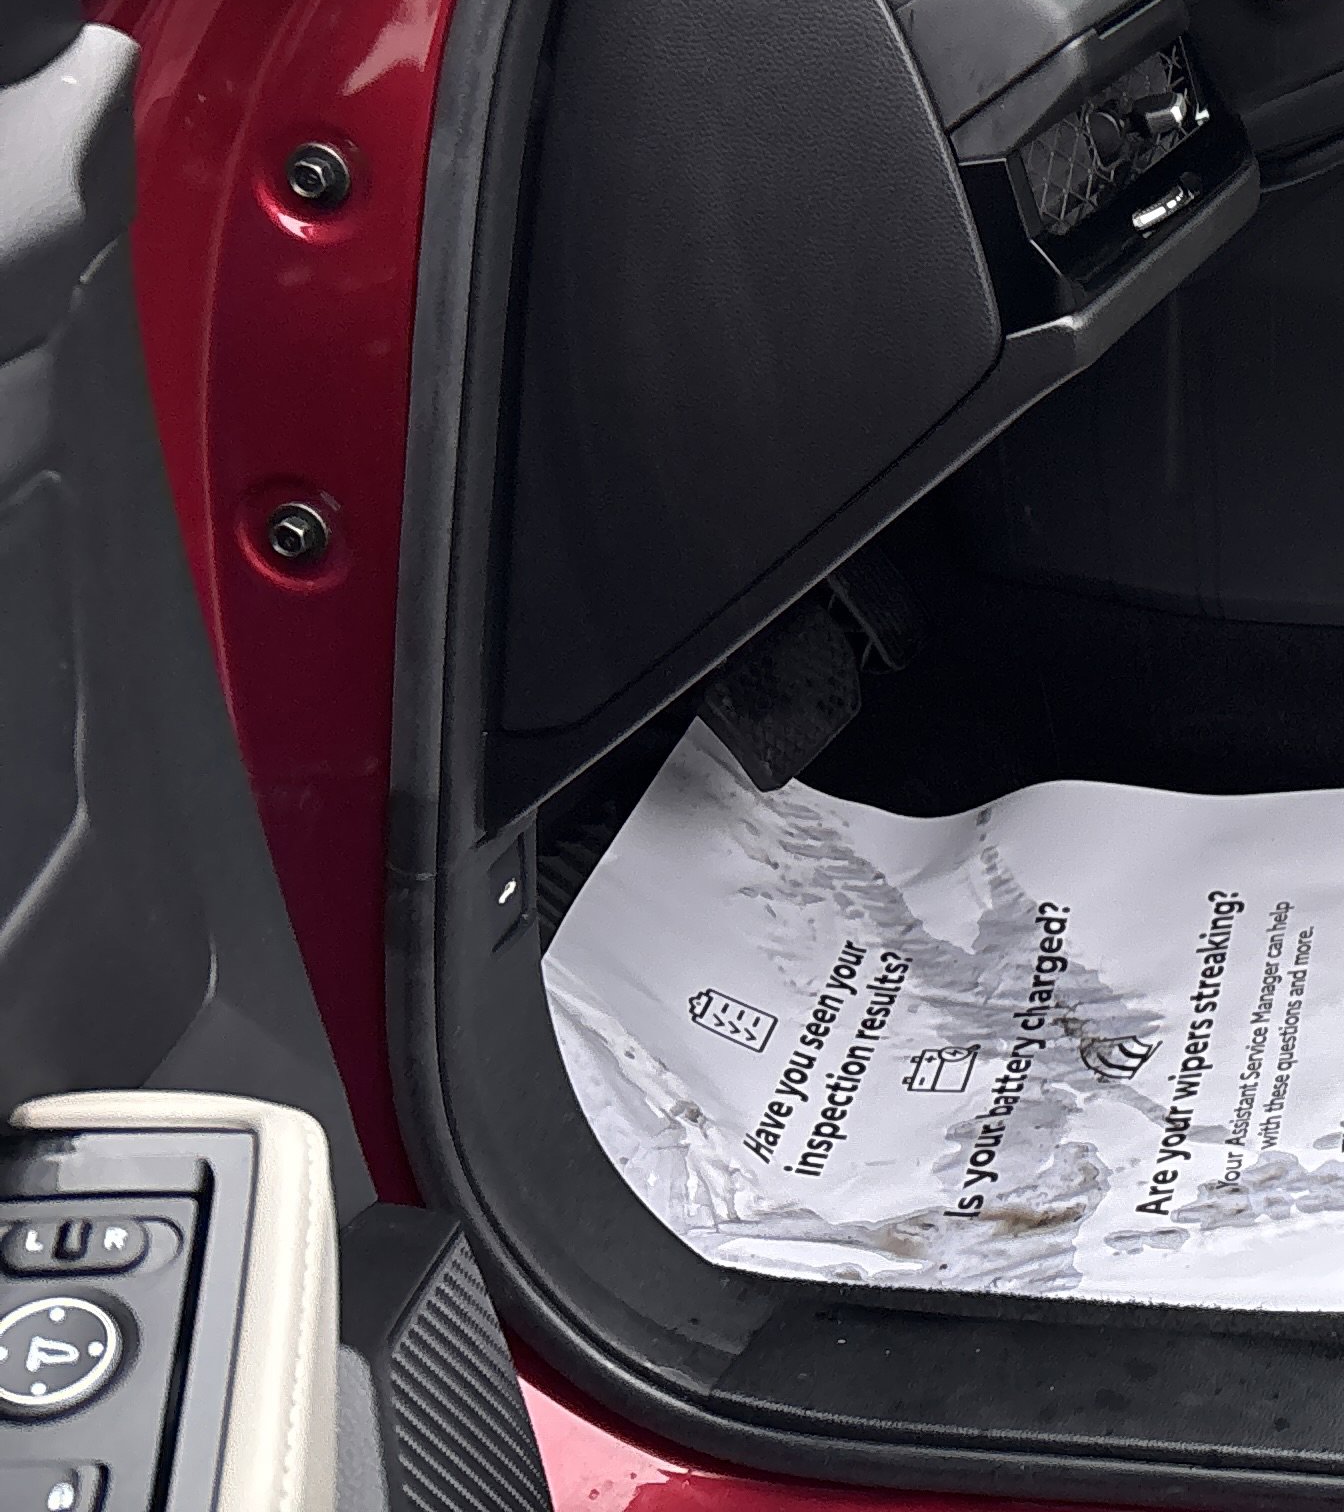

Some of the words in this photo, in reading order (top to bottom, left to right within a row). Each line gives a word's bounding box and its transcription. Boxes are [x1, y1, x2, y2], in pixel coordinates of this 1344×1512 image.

[1265, 901, 1294, 935] help
[1293, 925, 1314, 965] more.
[1009, 901, 1071, 1035] charged?
[1190, 890, 1244, 1012] streaking?
[1266, 933, 1283, 958] can
[1250, 961, 1282, 1023] Manager
[1286, 968, 1307, 996] and
[743, 1100, 793, 1163] Have
[774, 1050, 816, 1102] you
[799, 994, 843, 1050] seen
[825, 940, 866, 995] your
[1167, 1018, 1213, 1100] wipers
[1239, 1026, 1268, 1080] Service
[1277, 1000, 1304, 1070] questions
[784, 1045, 873, 1176] inspection
[856, 950, 913, 1040] results?
[975, 1030, 1047, 1120] battery
[1224, 1083, 1257, 1146] Assistant
[1262, 1073, 1290, 1112] these
[961, 1121, 1005, 1189] your
[1156, 1106, 1193, 1163] your
[1257, 1114, 1281, 1149] with
[1135, 1169, 1178, 1215] Are
[1216, 1150, 1243, 1189] Your
[942, 1188, 985, 1219] Is
[25, 1229, 43, 1251] L
[104, 1226, 127, 1250] R
